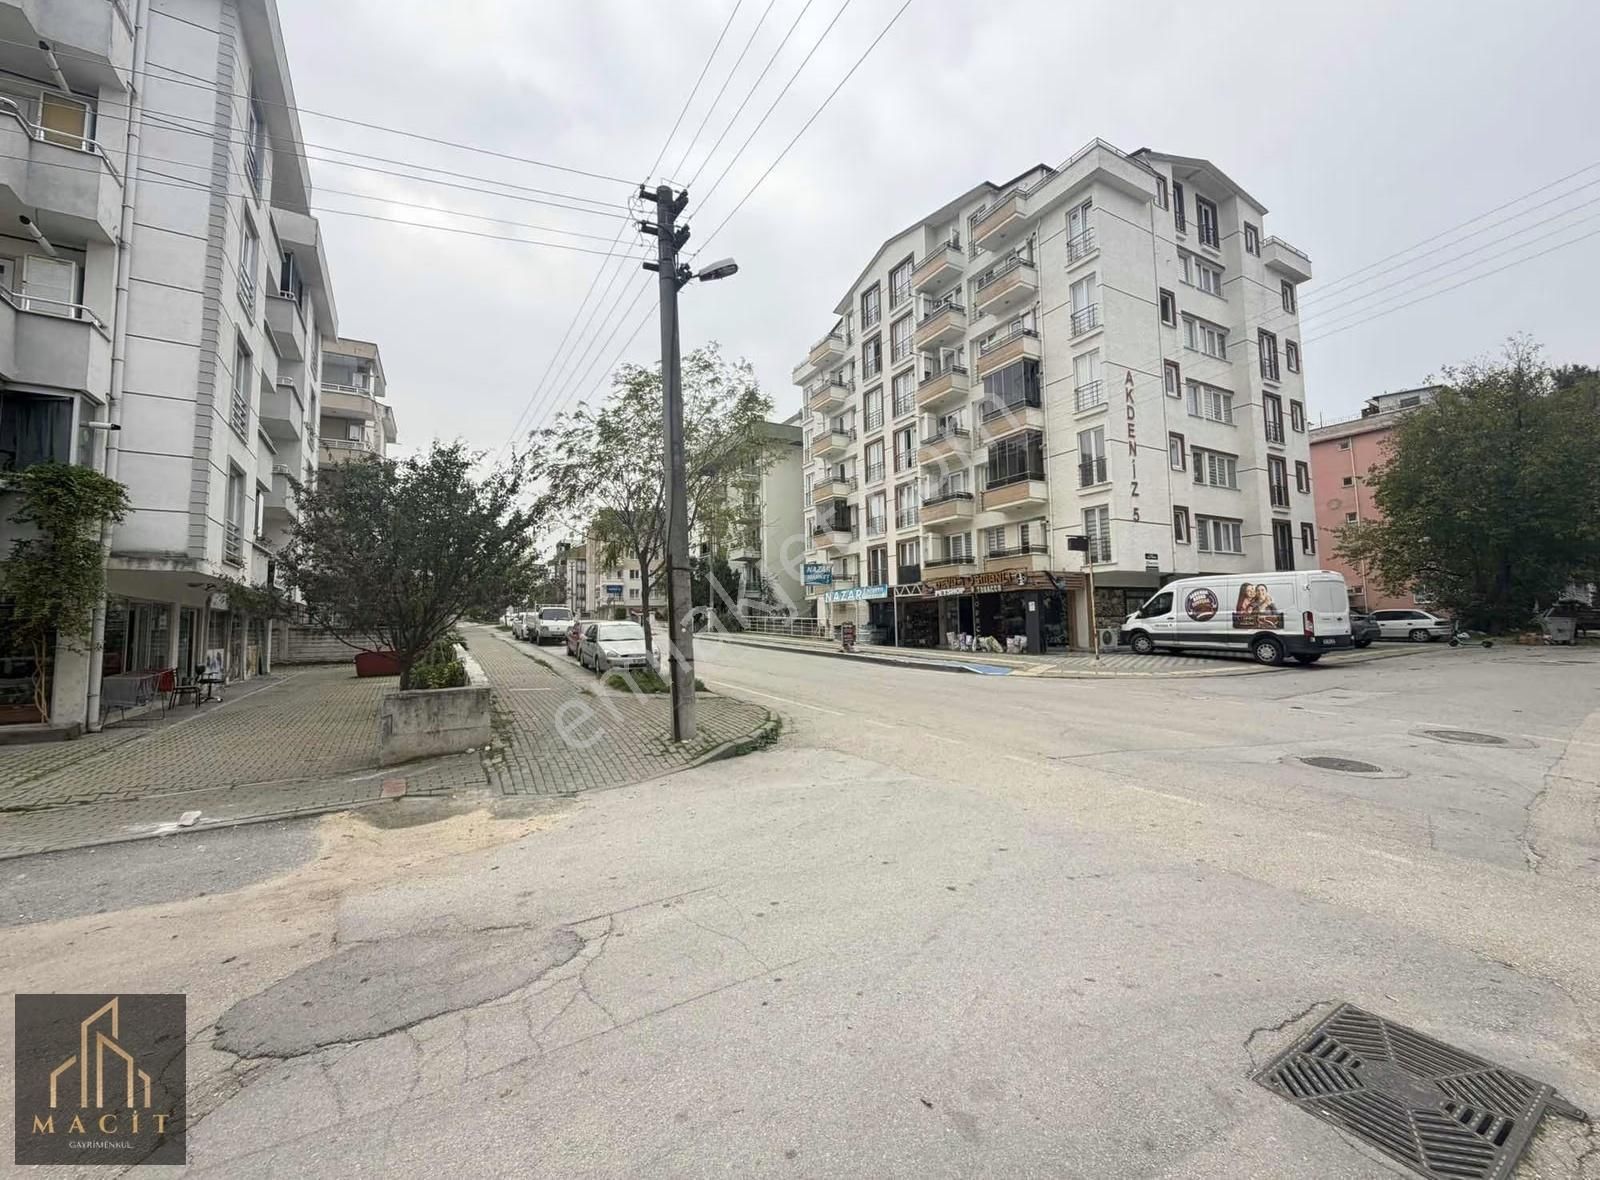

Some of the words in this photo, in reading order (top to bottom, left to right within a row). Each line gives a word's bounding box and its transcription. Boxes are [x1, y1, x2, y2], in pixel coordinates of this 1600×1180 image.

[1124, 370, 1140, 497] AKDENİZ
[1132, 507, 1140, 521] 5
[934, 587, 966, 597] PETSHOP
[976, 584, 1002, 593] TOBACCO
[825, 588, 863, 603] NAZAR
